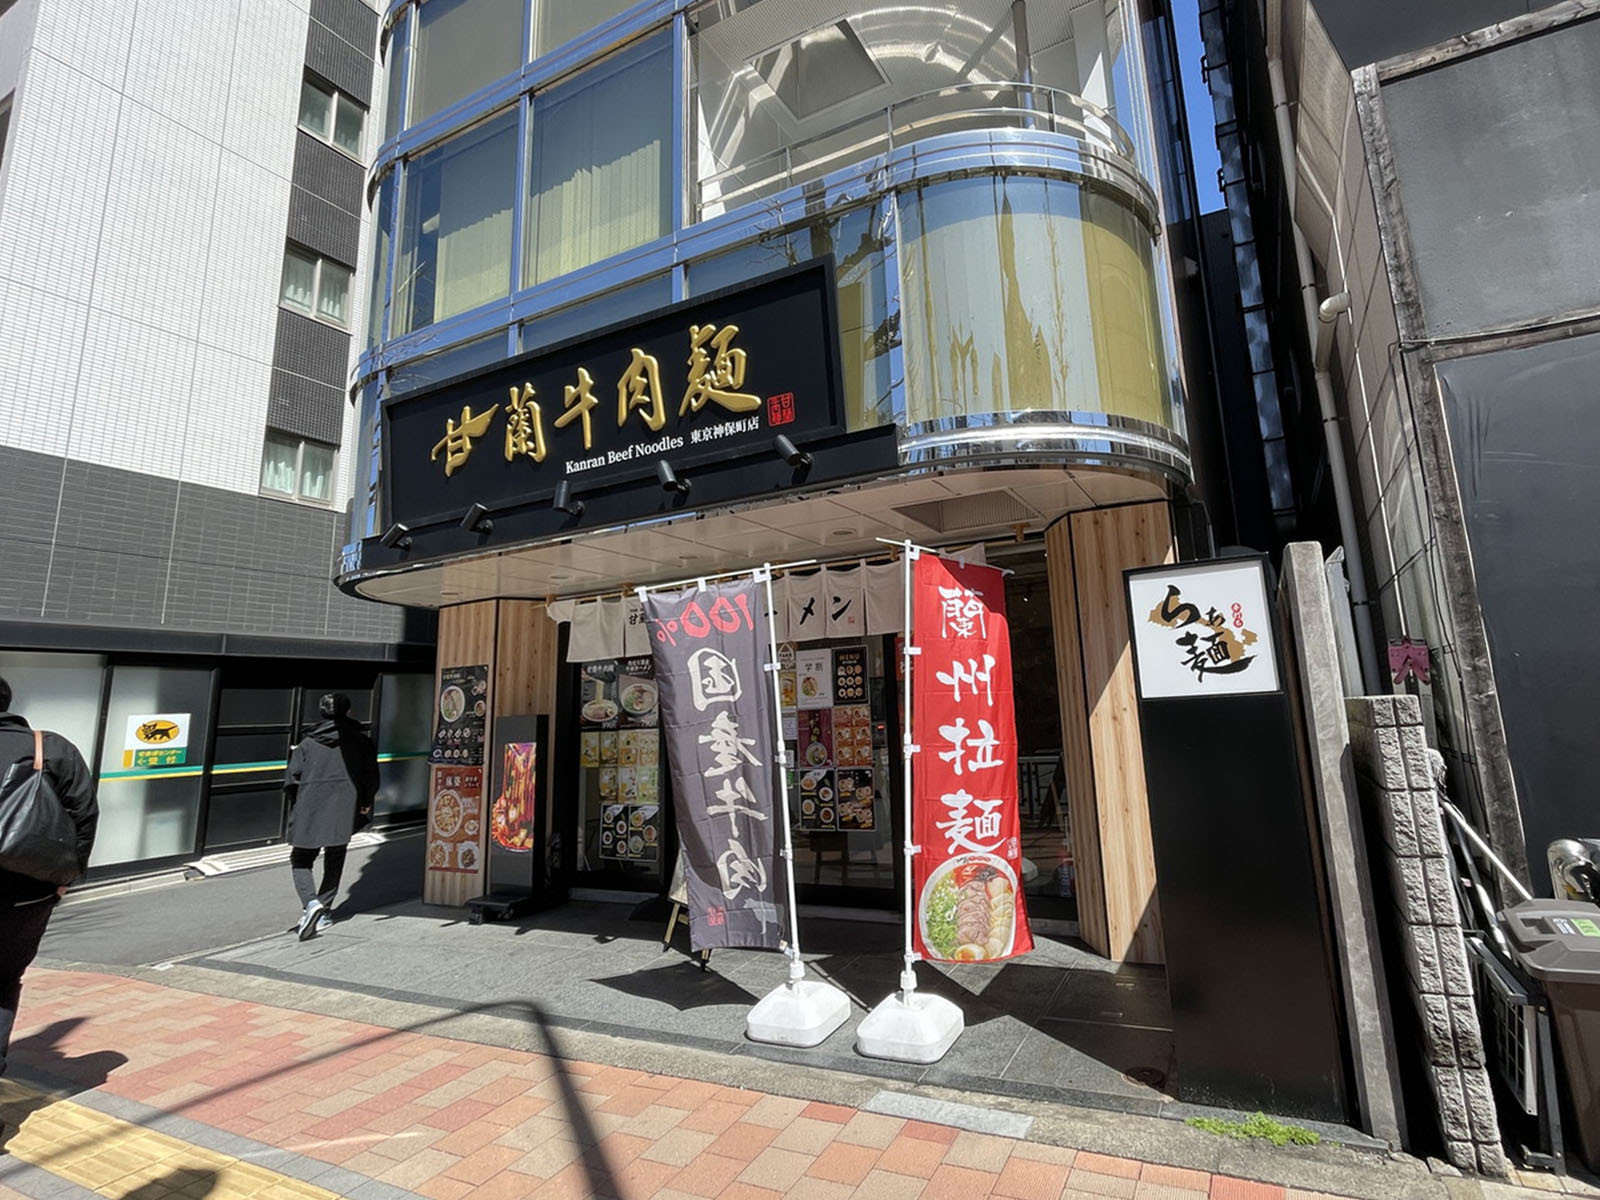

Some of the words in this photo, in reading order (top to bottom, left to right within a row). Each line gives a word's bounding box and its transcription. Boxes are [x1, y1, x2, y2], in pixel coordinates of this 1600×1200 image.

[565, 455, 606, 474] Kanran
[607, 443, 635, 463] Beef
[635, 435, 684, 457] Noodles
[690, 416, 760, 445] 東京神保町店
